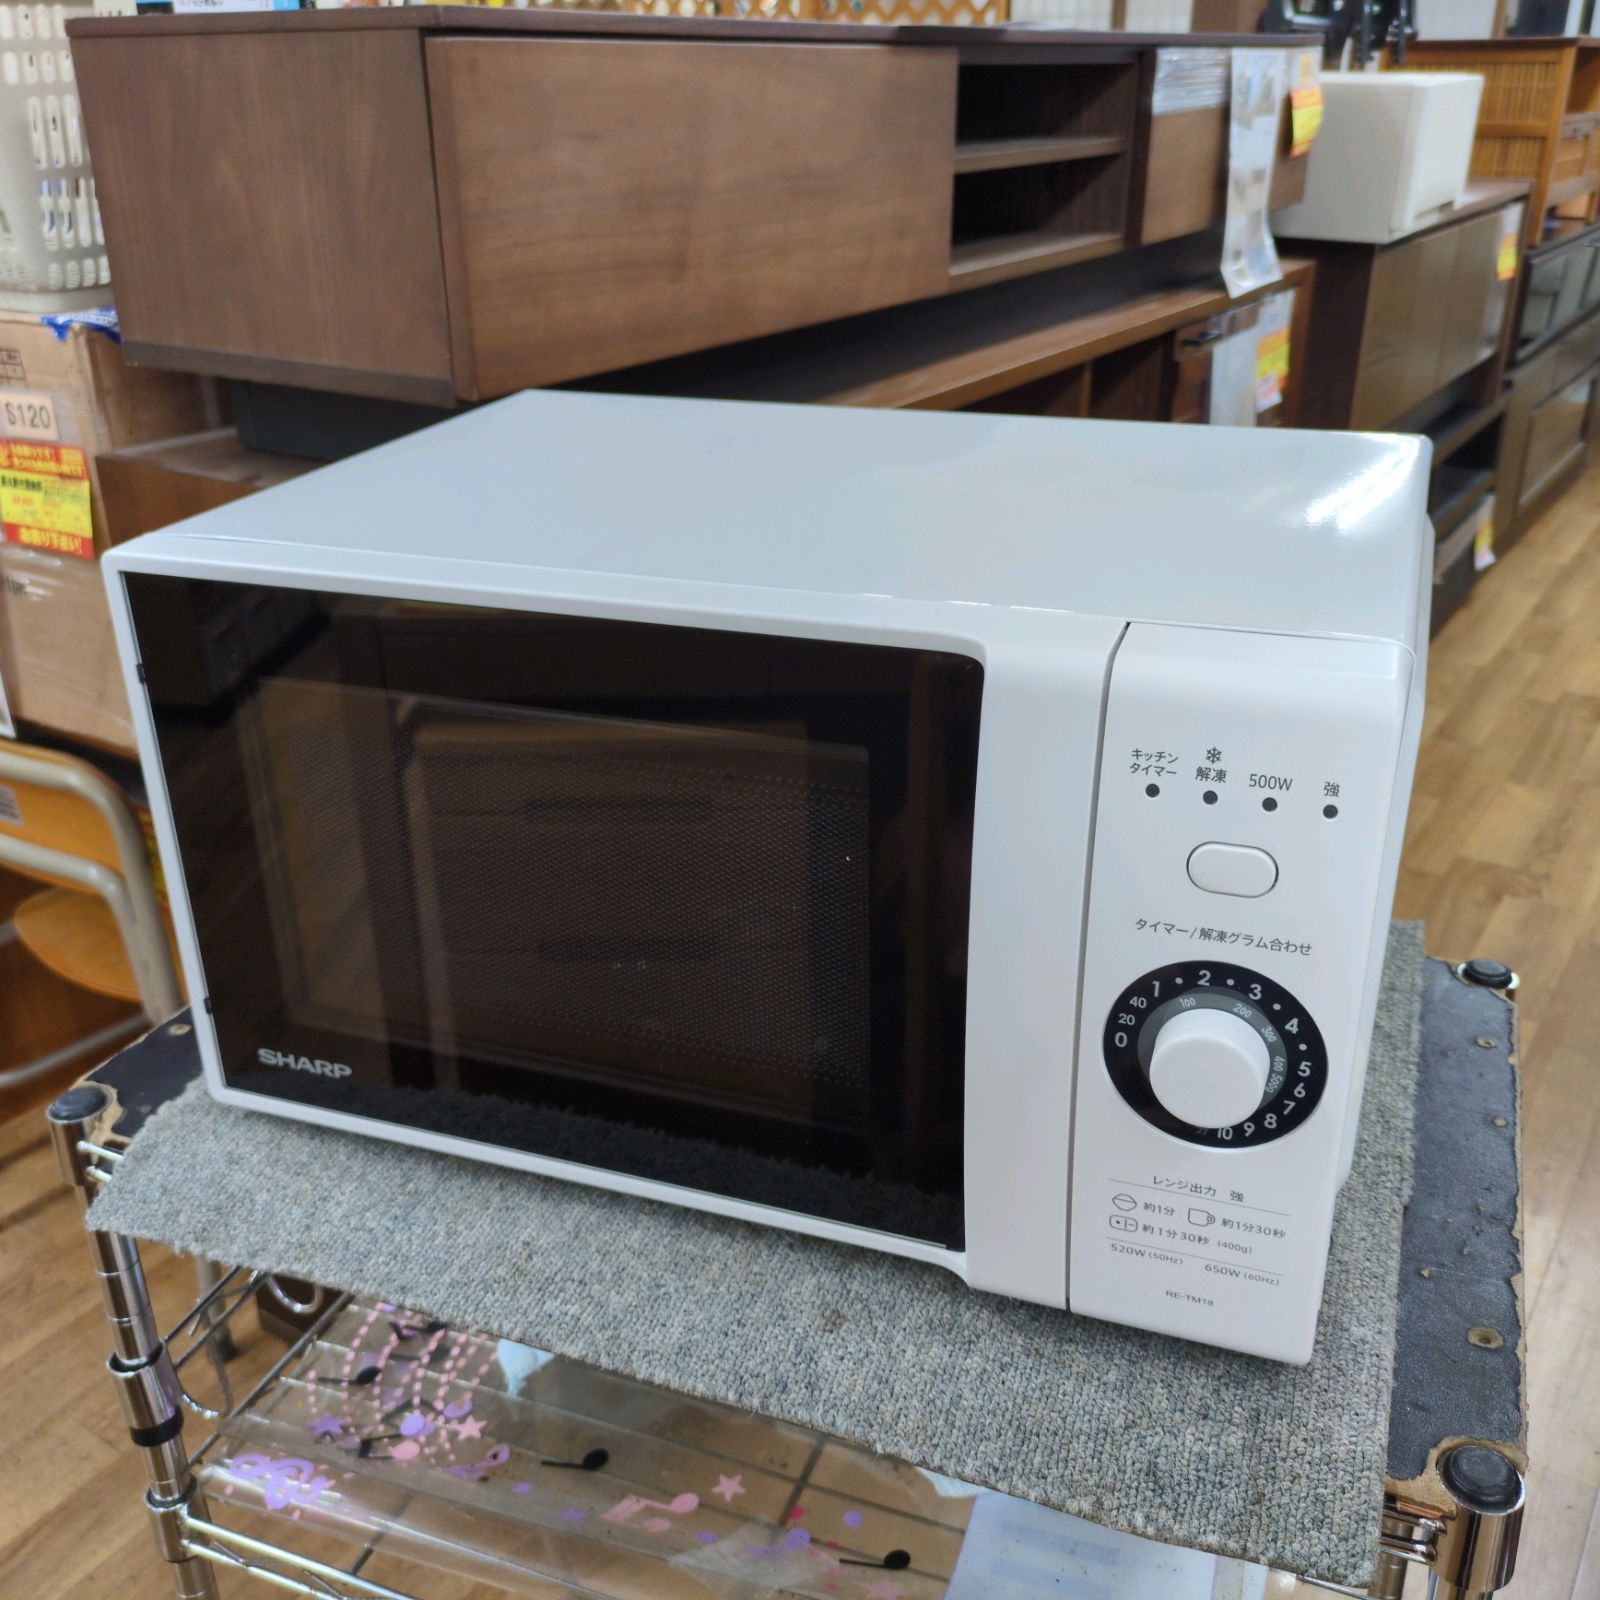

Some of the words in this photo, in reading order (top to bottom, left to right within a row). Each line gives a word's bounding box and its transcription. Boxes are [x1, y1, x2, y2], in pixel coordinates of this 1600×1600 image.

[1131, 748, 1179, 764] キッチン
[1129, 762, 1177, 777] タイマー
[1195, 766, 1227, 783] 解凍
[1248, 773, 1293, 791] 500W
[1323, 781, 1341, 797] 強
[1197, 970, 1211, 986] 2
[1152, 981, 1160, 998] 1
[1249, 983, 1262, 1000] 3
[1129, 996, 1147, 1009] 40
[1118, 1013, 1136, 1026] 20
[1285, 1018, 1299, 1034] 4
[1115, 1032, 1128, 1048] 0
[1179, 997, 1196, 1009] 100
[1232, 1002, 1252, 1019] 200
[1261, 1025, 1277, 1043] 300
[1273, 1055, 1286, 1072] 400
[258, 1048, 352, 1078] SHARP
[1298, 1061, 1311, 1077] 5
[1293, 1083, 1306, 1098] 6
[1283, 1100, 1296, 1115] 7
[1264, 1113, 1278, 1129] 8
[1217, 1126, 1233, 1140] 10
[1243, 1122, 1255, 1137] 9
[1153, 1175, 1217, 1197] レンジ出力
[1229, 1190, 1244, 1203] 強
[1143, 1202, 1175, 1217] 約1分
[1221, 1218, 1286, 1239] 約1分30秒
[1217, 1240, 1252, 1254] (400g)
[1165, 1290, 1214, 1307] RE-TM18
